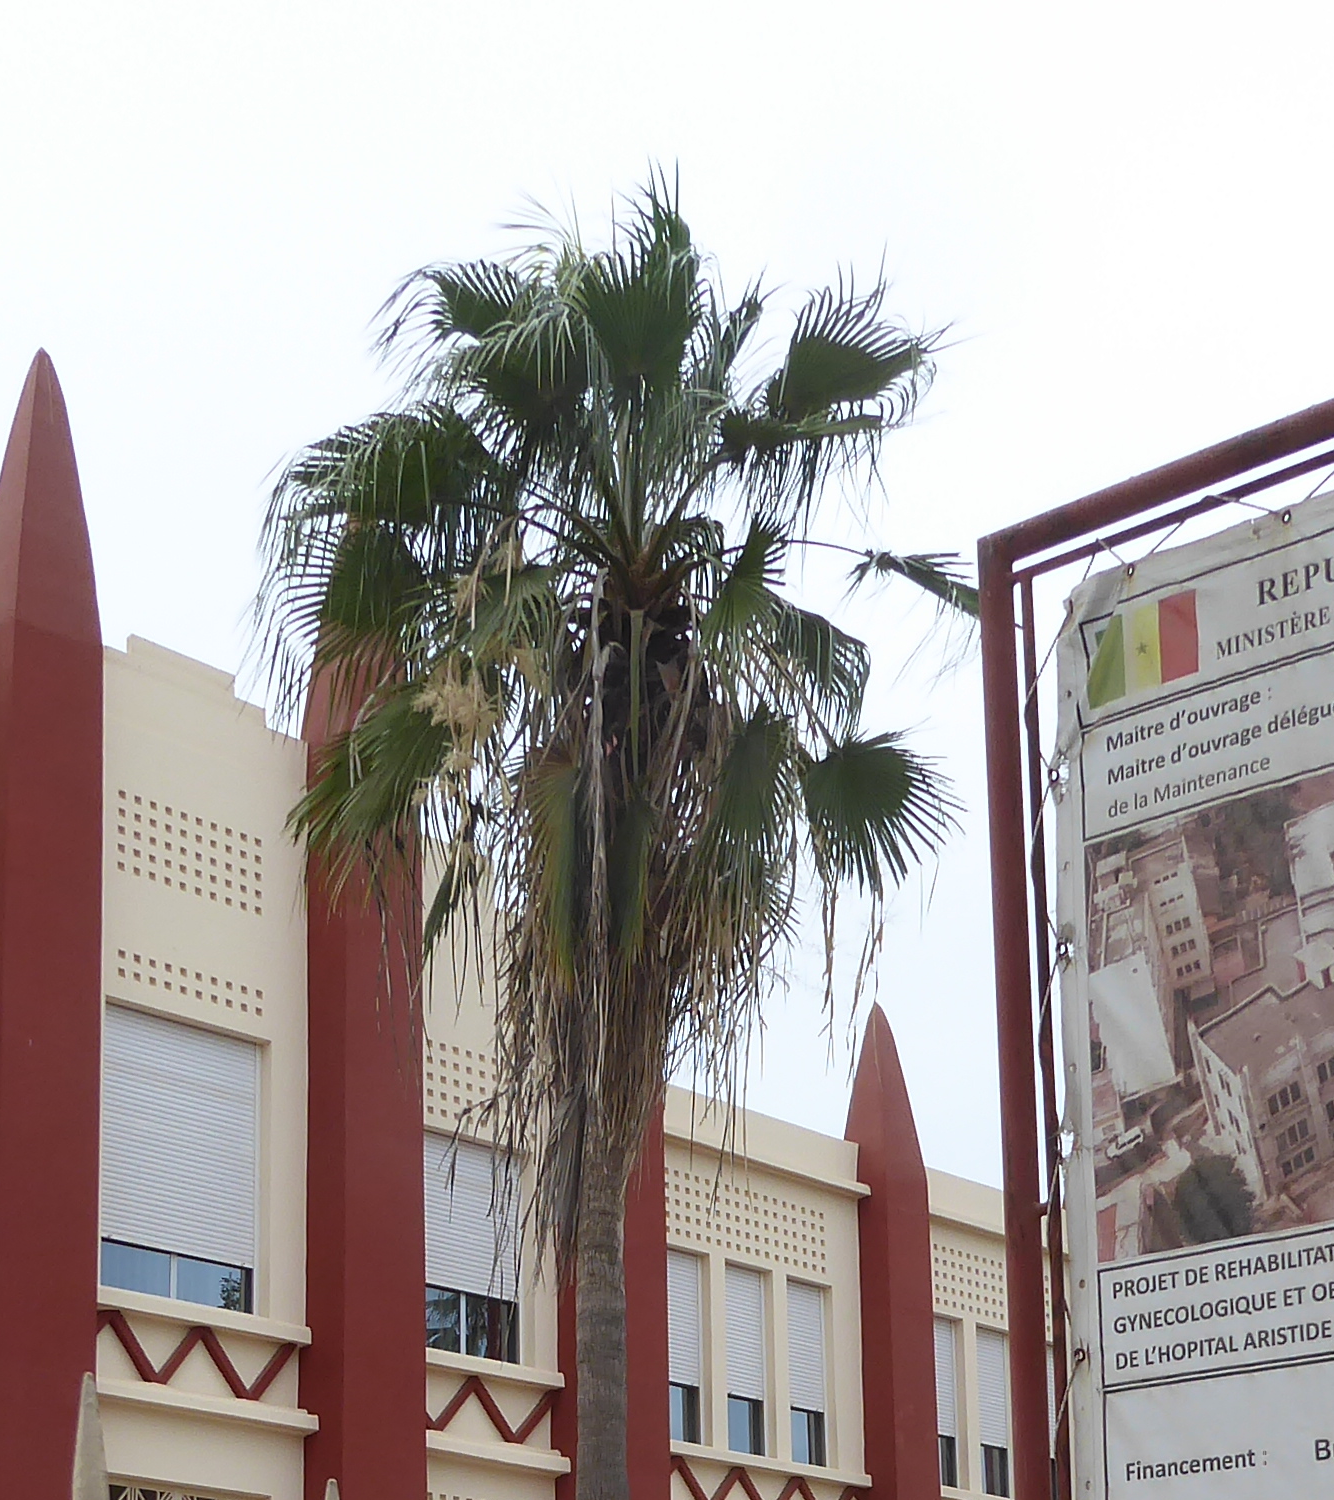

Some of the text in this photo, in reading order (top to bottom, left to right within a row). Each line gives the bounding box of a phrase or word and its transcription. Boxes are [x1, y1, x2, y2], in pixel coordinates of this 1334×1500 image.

[1216, 605, 1331, 660] MINISTÈRE
[1169, 690, 1262, 731] d’ouvrage
[1170, 724, 1262, 765] d’ouvrage
[1107, 757, 1271, 819] de la Maintenance
[1112, 1270, 1180, 1300] PROJET
[1184, 1265, 1210, 1287] DE
[1113, 1290, 1278, 1335] GYNECOLOGIQUE
[1282, 1285, 1307, 1308] ET
[1115, 1349, 1140, 1371] DE
[1144, 1334, 1240, 1366] L’HOPITAL
[1243, 1319, 1333, 1352] ARISTIDE
[1125, 1448, 1257, 1482] Financement
